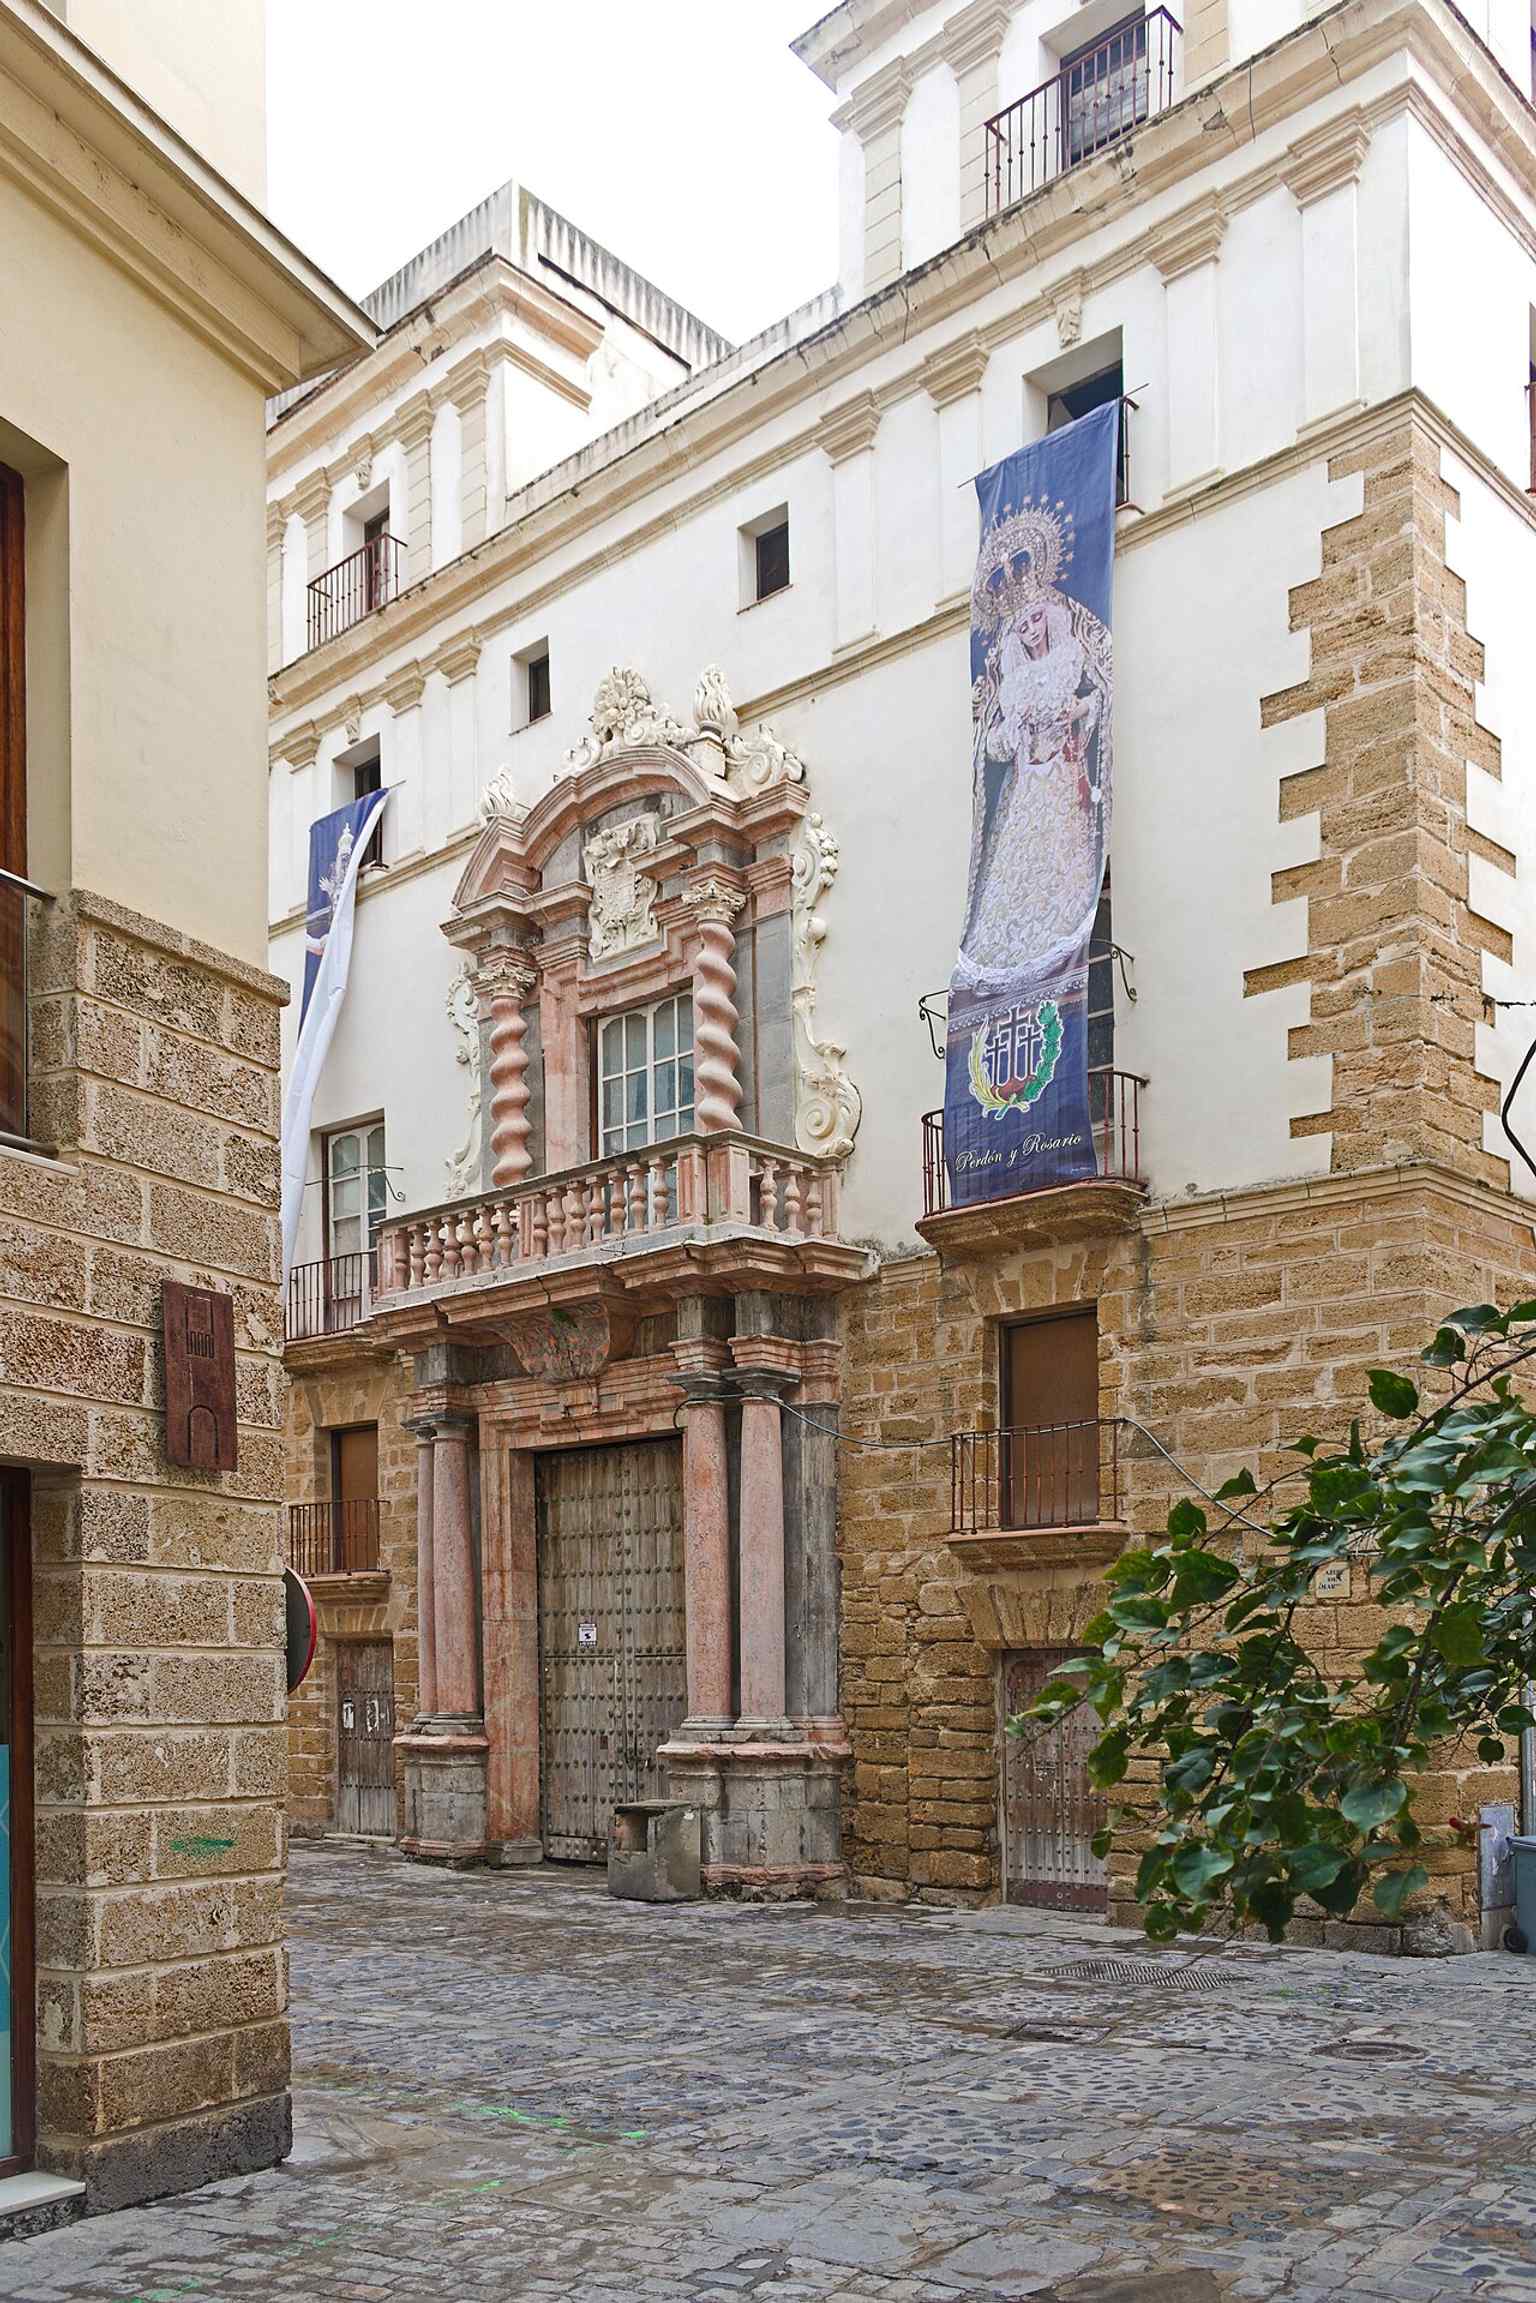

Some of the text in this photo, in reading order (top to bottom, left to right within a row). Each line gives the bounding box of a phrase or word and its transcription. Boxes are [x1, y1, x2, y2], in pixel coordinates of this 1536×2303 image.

[956, 1132, 1082, 1172] Perdón y Rosario
